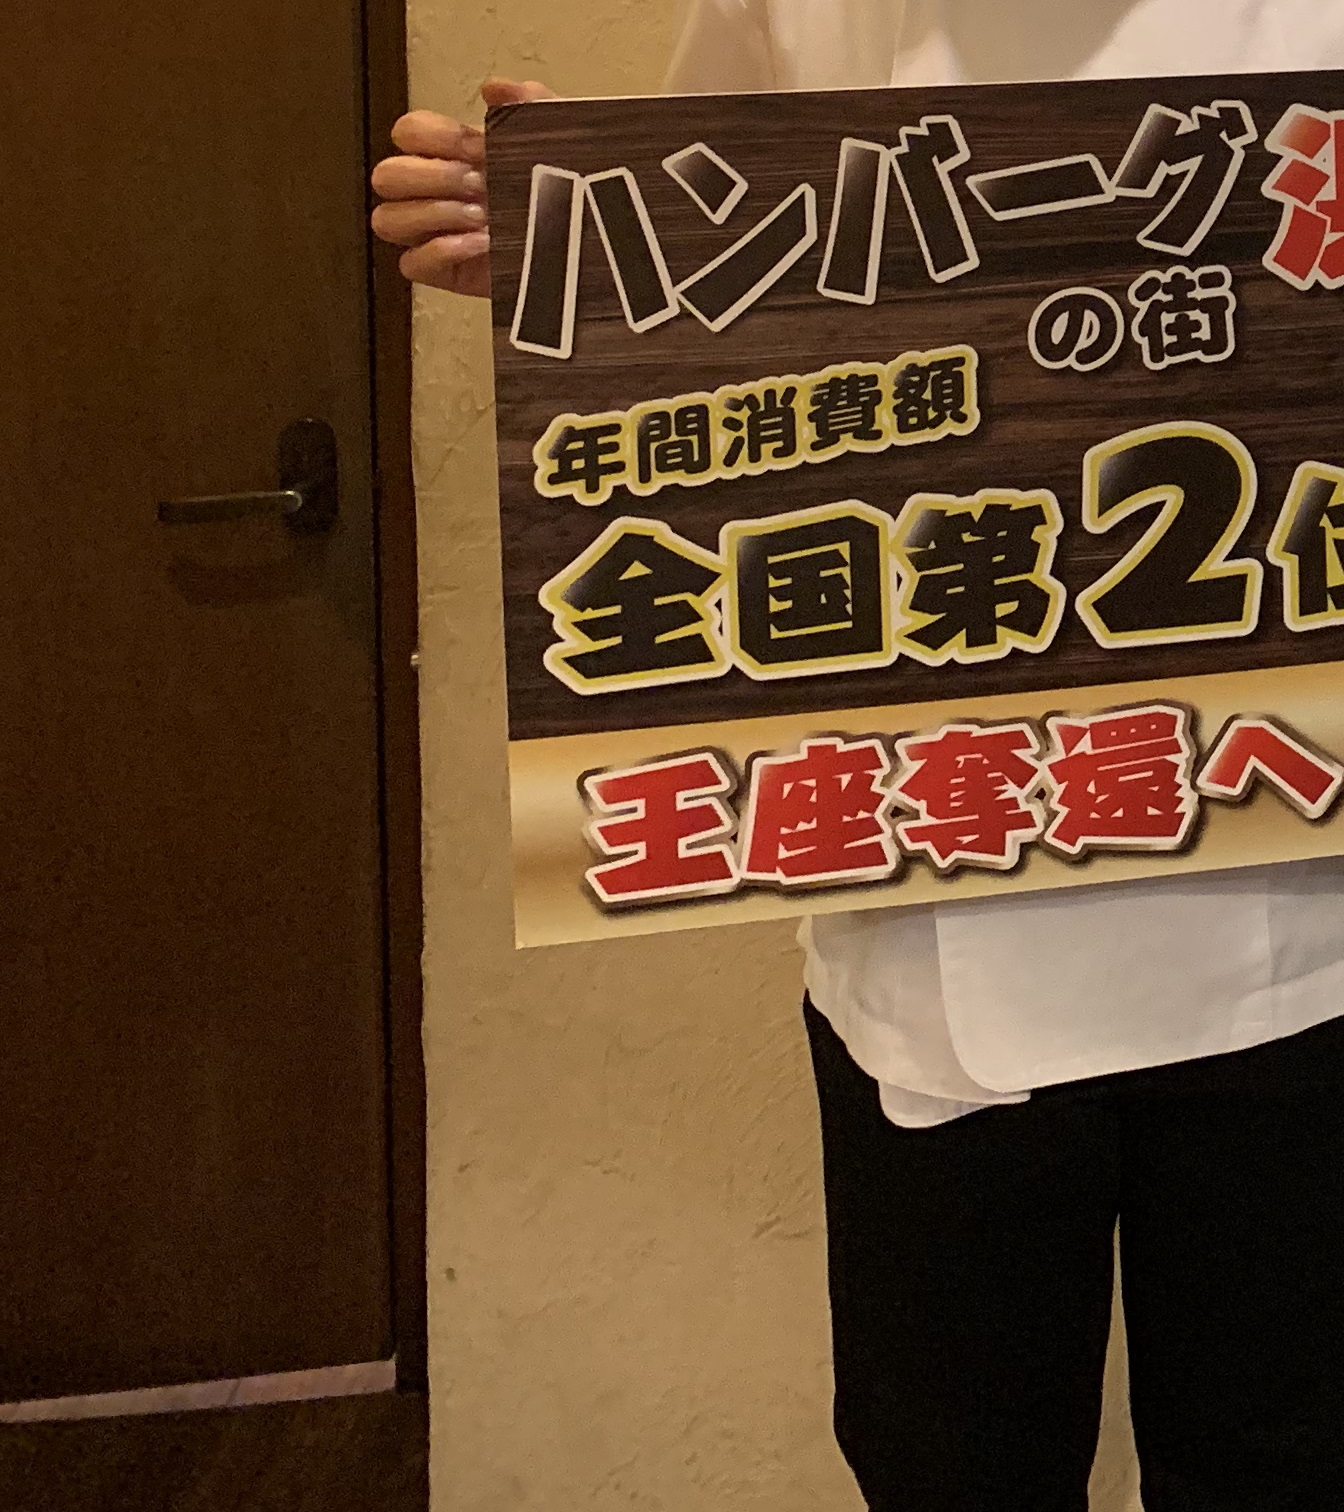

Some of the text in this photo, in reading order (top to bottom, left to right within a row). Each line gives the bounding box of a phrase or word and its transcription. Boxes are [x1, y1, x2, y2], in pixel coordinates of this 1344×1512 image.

[510, 100, 1257, 360] ハンバーグ
[1028, 265, 1237, 371] の街
[534, 345, 979, 506] 年間消費額
